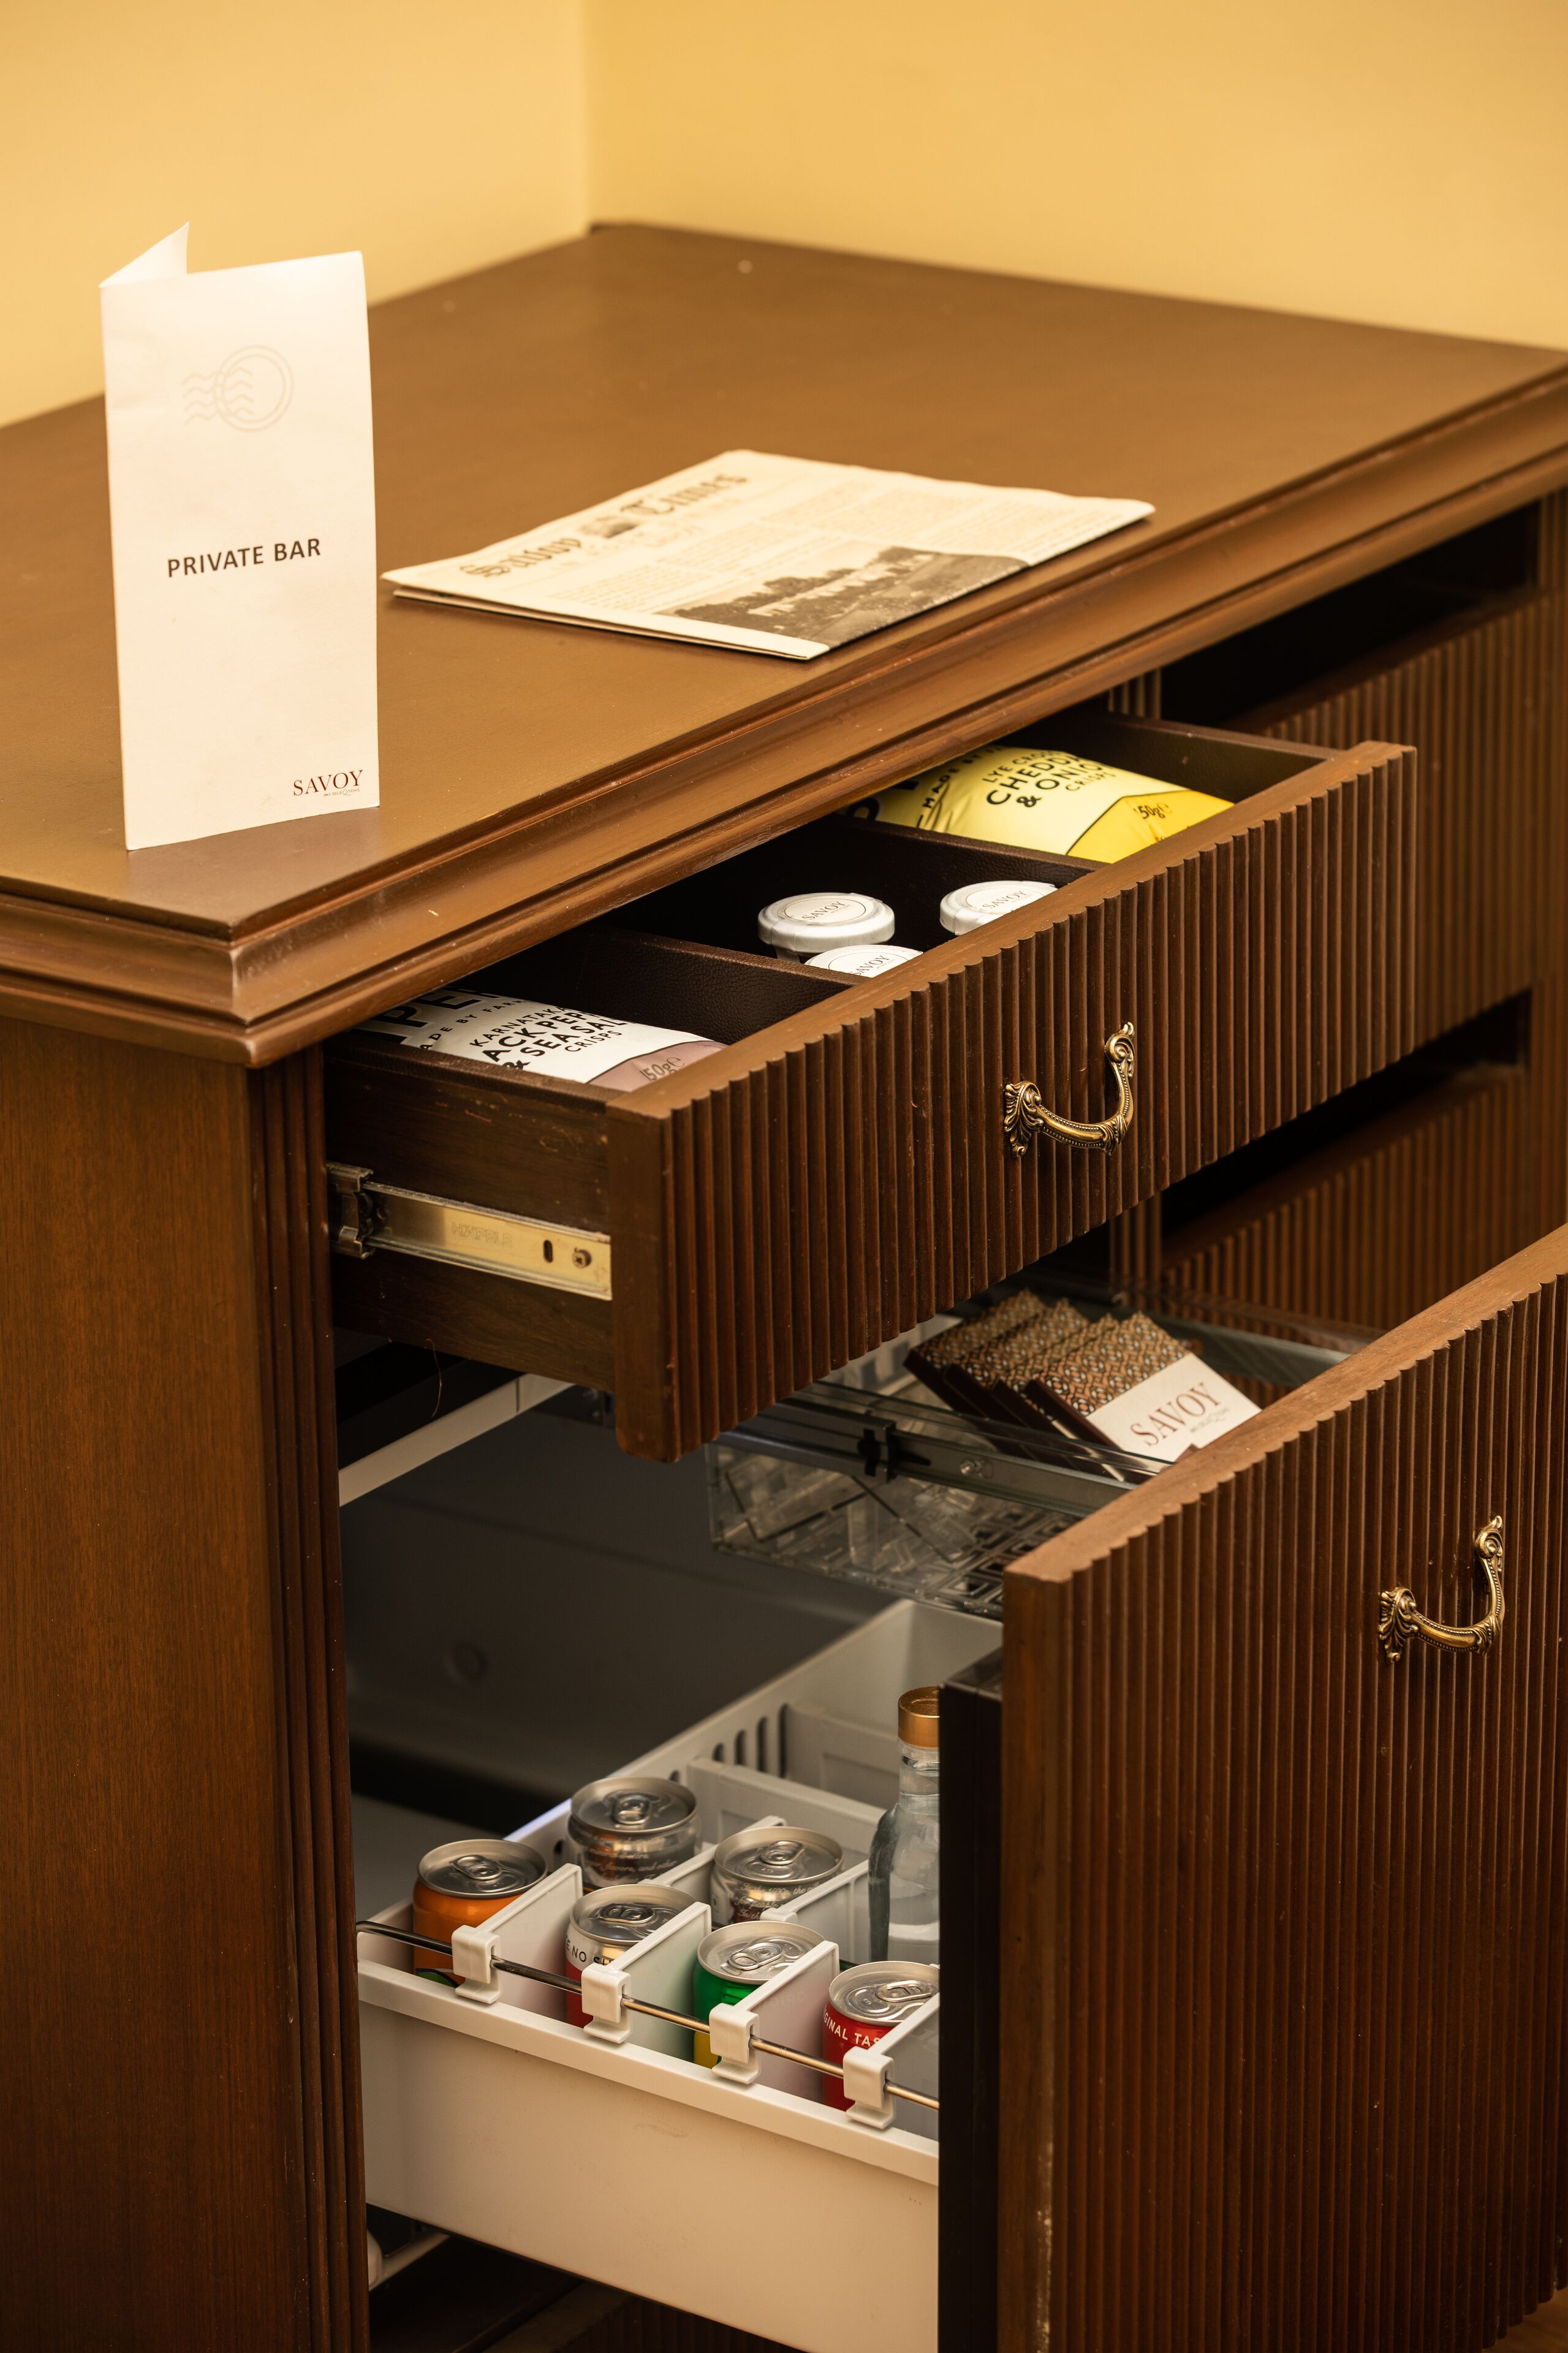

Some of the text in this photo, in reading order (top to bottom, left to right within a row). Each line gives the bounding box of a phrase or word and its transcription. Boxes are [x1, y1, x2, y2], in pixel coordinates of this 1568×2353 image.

[167, 538, 320, 578] PRIVATE BAR
[293, 770, 363, 796] SAVOY
[982, 765, 1014, 783] LYE
[986, 754, 1082, 805] CHEDDA
[1016, 762, 1105, 808] & ONIO
[1065, 771, 1116, 792] CRISPS
[802, 901, 846, 920] SAVOY
[983, 889, 1029, 909] SAVOY
[419, 1026, 453, 1050] ADE
[456, 1014, 477, 1024] BY
[469, 1006, 570, 1047] KARNATAKA
[520, 1032, 580, 1056] SEA
[570, 1017, 631, 1034] SAL
[482, 1027, 547, 1062] ACK
[564, 1030, 623, 1052] CRISPS
[1129, 1382, 1221, 1447] SAVOY
[792, 1885, 806, 1895] the
[572, 1945, 587, 1963] NO
[854, 2032, 881, 2047] TAS
